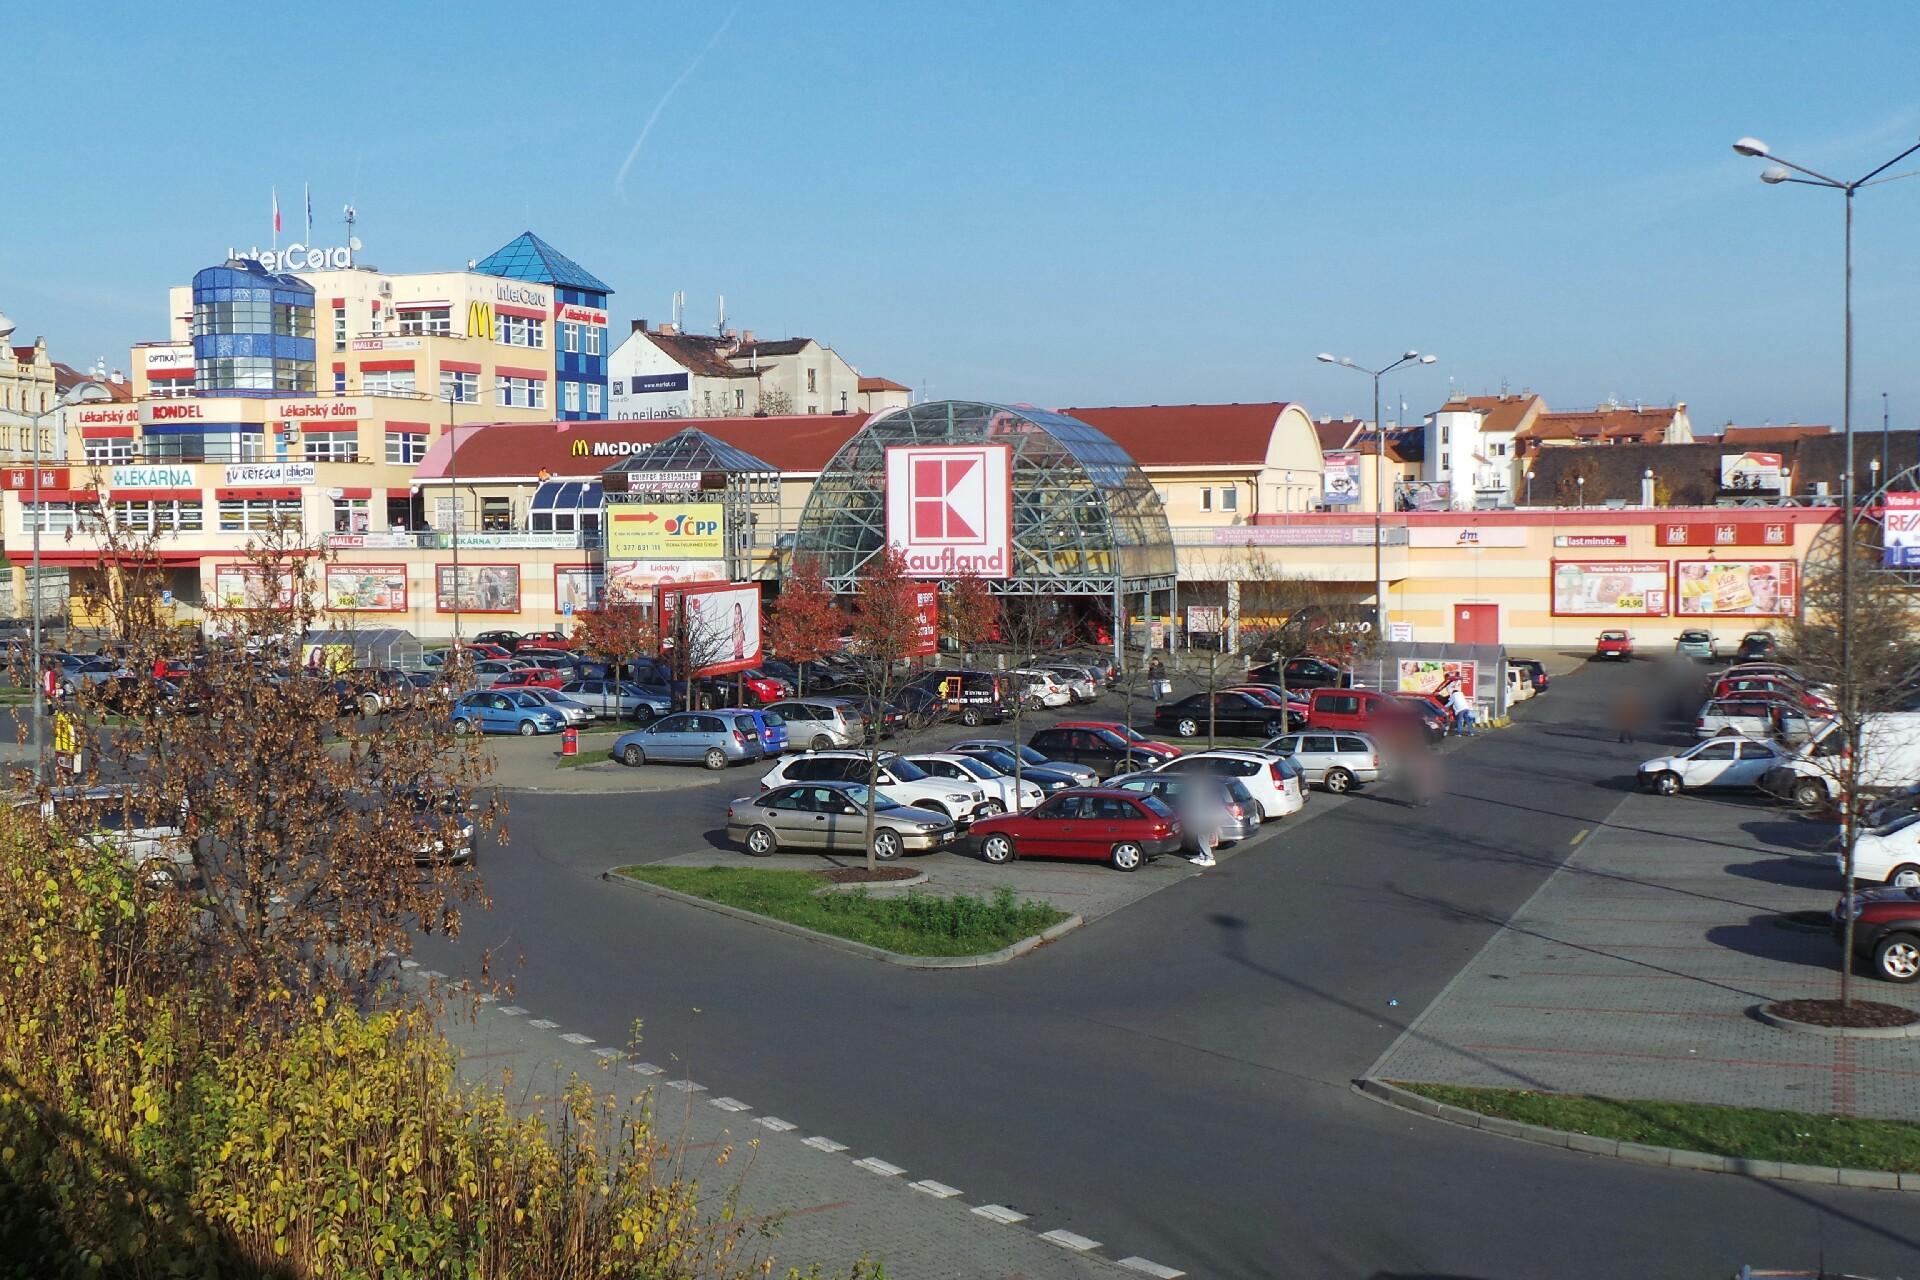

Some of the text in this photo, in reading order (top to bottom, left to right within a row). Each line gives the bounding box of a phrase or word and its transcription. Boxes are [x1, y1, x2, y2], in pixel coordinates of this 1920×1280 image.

[149, 355, 175, 363] OPTIKA
[80, 408, 139, 424] Lékařský dů
[153, 405, 203, 420] RONDEL
[281, 403, 357, 418] Lékařský dům
[593, 442, 659, 456] McDon
[12, 470, 25, 485] kik
[41, 470, 55, 485] kik
[124, 468, 192, 486] LÉKÁRNA
[1887, 496, 1914, 506] Vaše
[684, 516, 717, 535] ČPP
[330, 537, 362, 545] MALL.CZ
[1460, 529, 1477, 540] dm
[1668, 526, 1686, 541] kik
[1717, 526, 1734, 541] kik
[1766, 526, 1784, 541] kik
[650, 564, 680, 574] Lidovky
